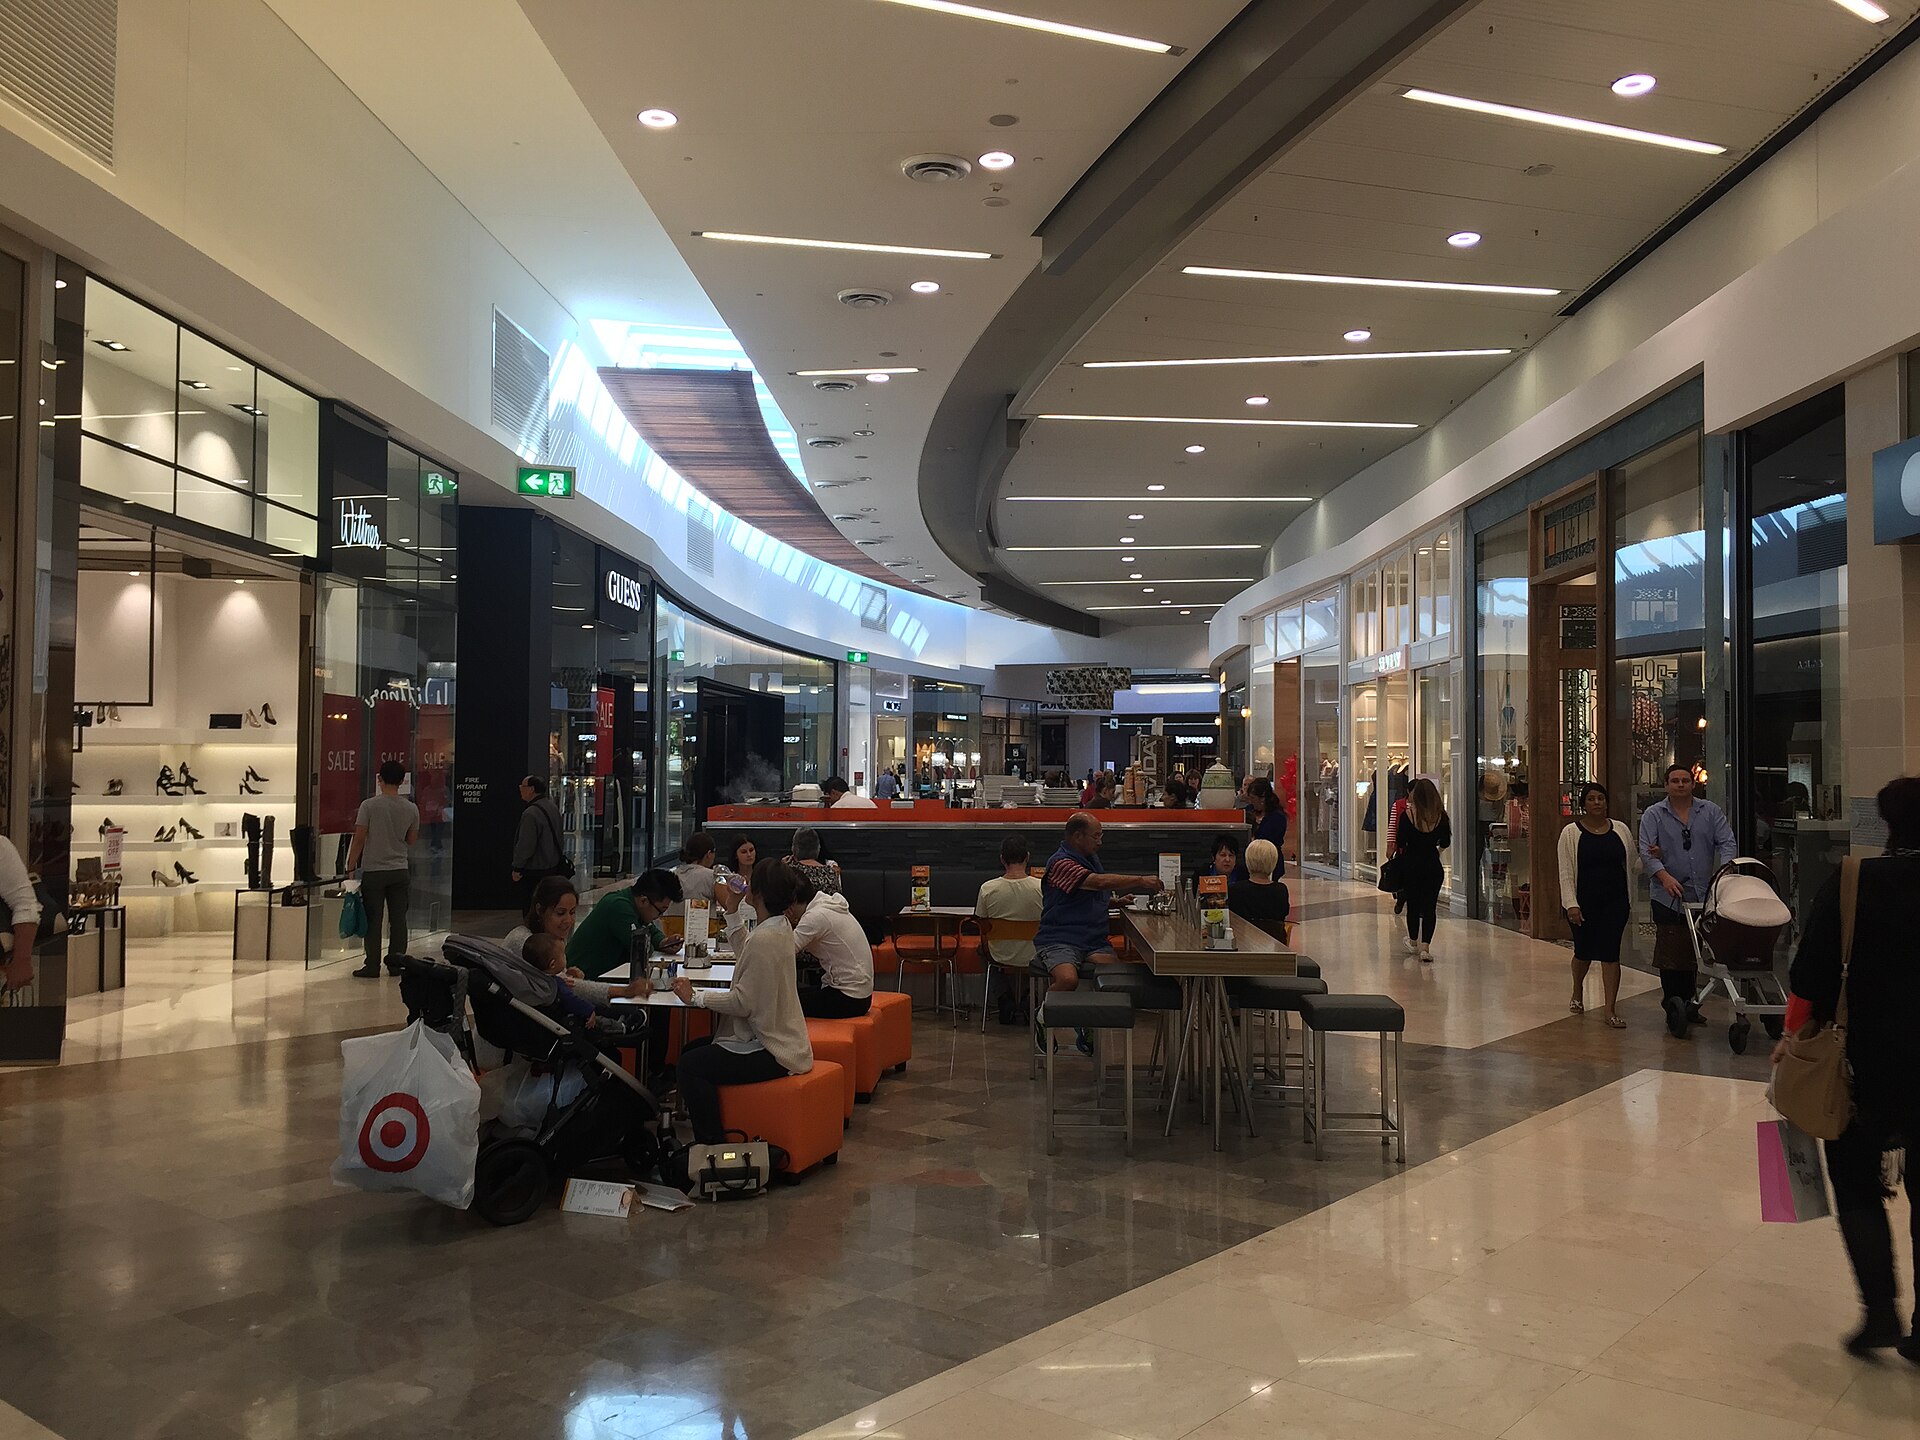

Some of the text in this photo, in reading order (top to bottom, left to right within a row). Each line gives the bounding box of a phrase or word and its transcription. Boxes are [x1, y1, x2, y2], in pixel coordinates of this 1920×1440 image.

[607, 570, 641, 612] GUESS
[596, 701, 614, 729] SALE
[327, 750, 356, 771] SALE
[423, 752, 445, 769] SALE
